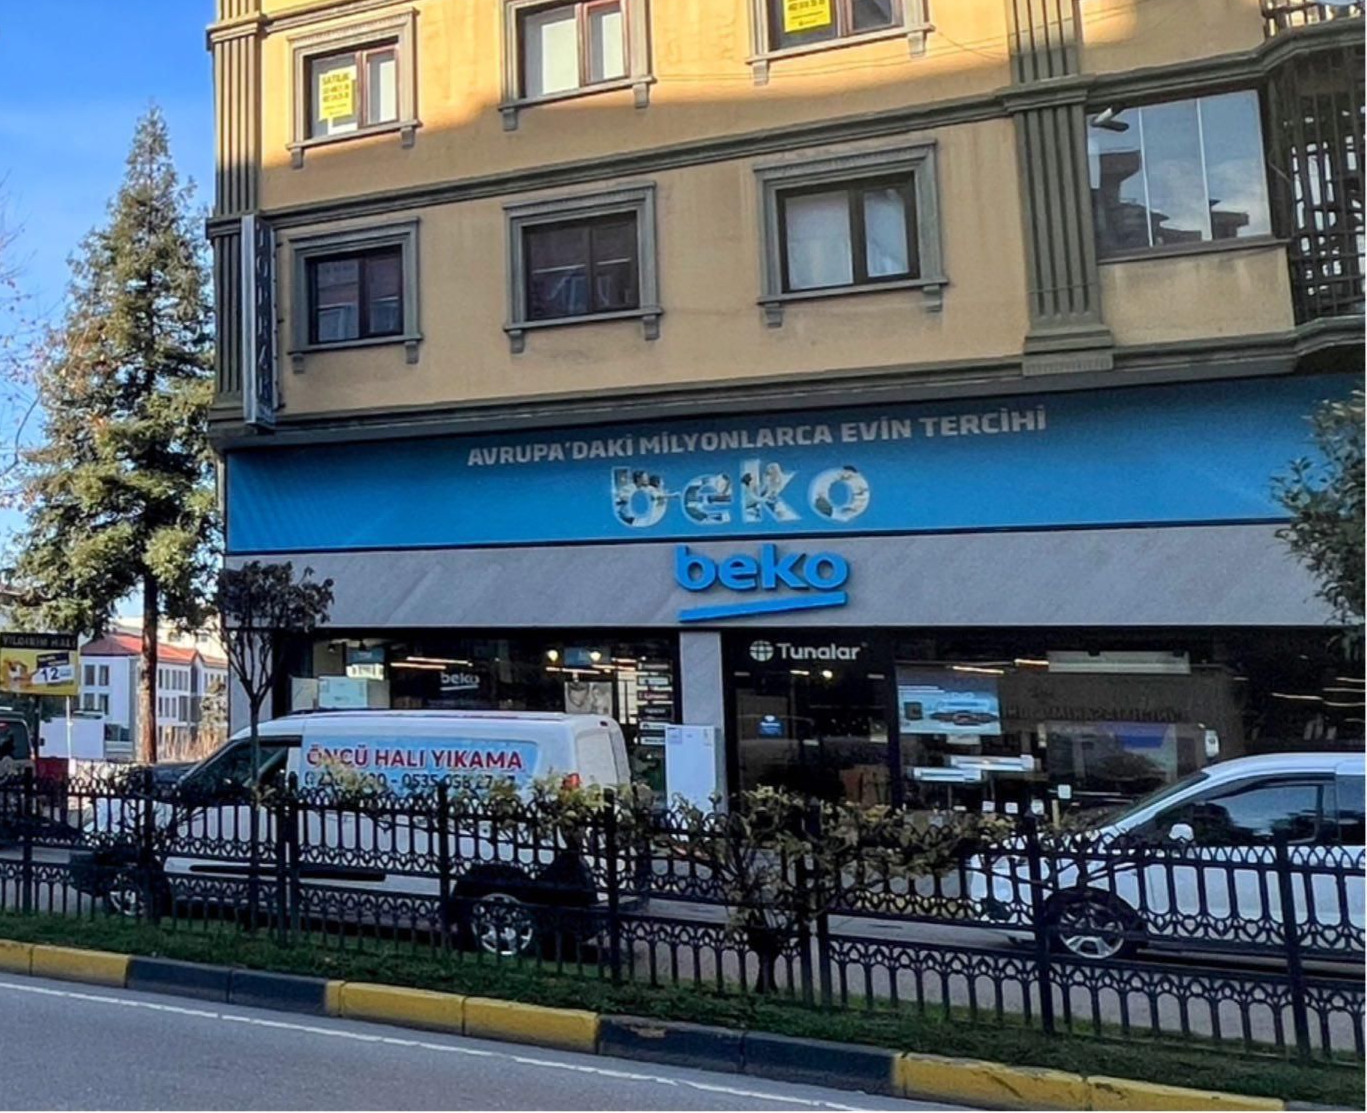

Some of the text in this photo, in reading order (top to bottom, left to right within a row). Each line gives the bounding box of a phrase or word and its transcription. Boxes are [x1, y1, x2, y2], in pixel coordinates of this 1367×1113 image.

[639, 424, 833, 455] MİLYONLARCA
[841, 417, 912, 443] EVİN
[919, 405, 1047, 437] TERCİHİ
[611, 458, 871, 528] beko
[675, 543, 850, 592] beko
[776, 643, 861, 660] Tunalar
[41, 667, 59, 682] 12
[440, 671, 480, 685] beko
[307, 744, 523, 769] ÖNCÜ HALI YIKAMA
[402, 773, 438, 787] 0535
